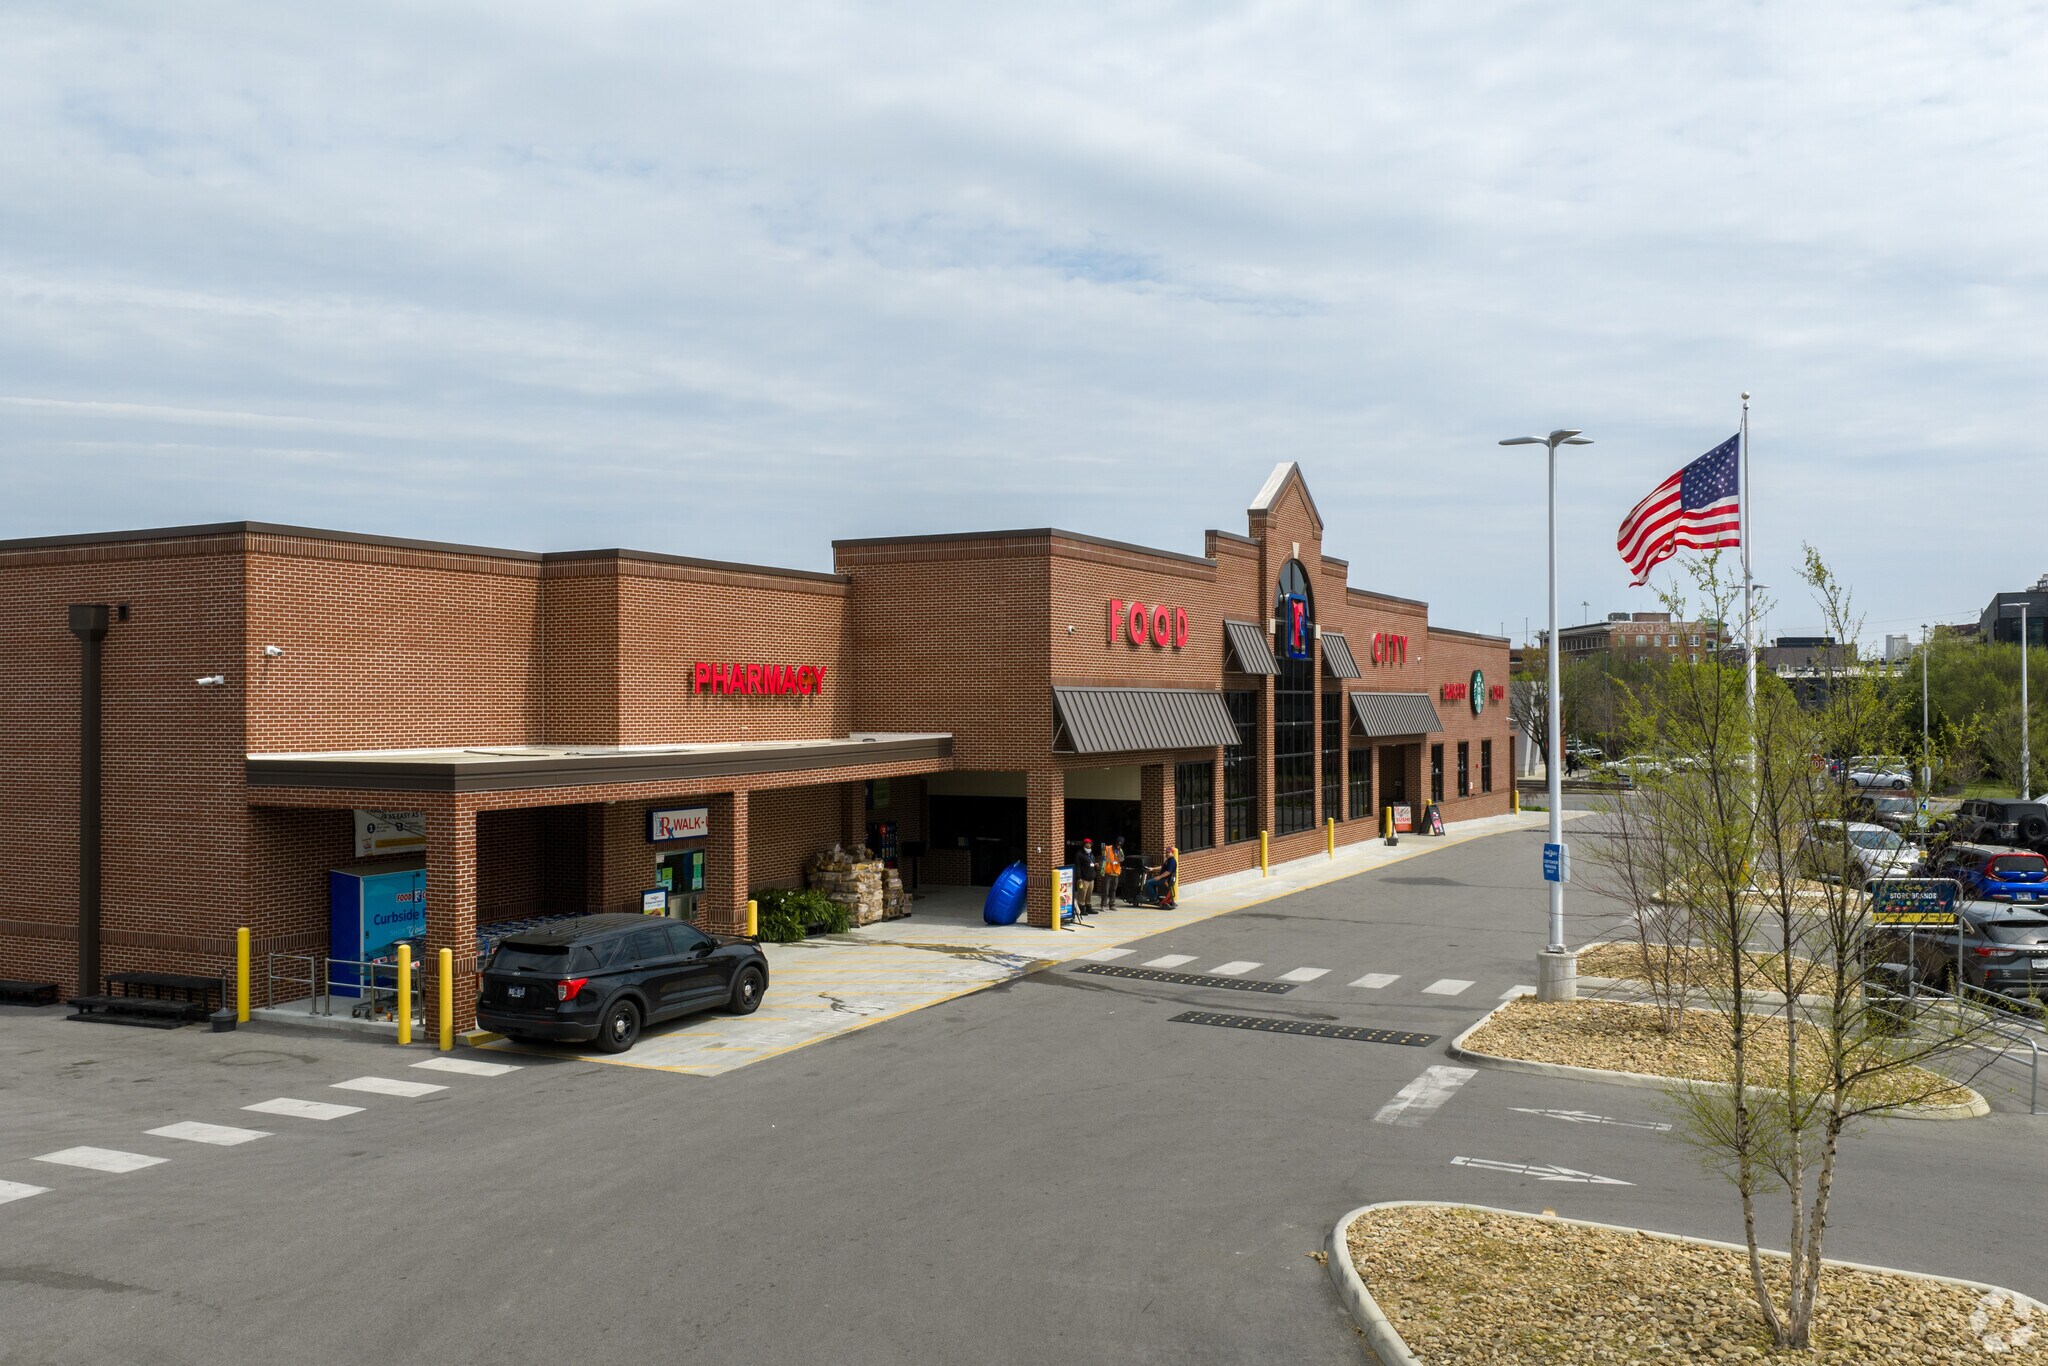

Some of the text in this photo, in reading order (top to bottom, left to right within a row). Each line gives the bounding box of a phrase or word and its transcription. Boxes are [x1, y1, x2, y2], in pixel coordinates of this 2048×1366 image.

[1108, 599, 1189, 648] FOOD
[1372, 632, 1408, 663] CITY
[694, 661, 827, 695] PHARMACY
[374, 909, 419, 925] Curbside
